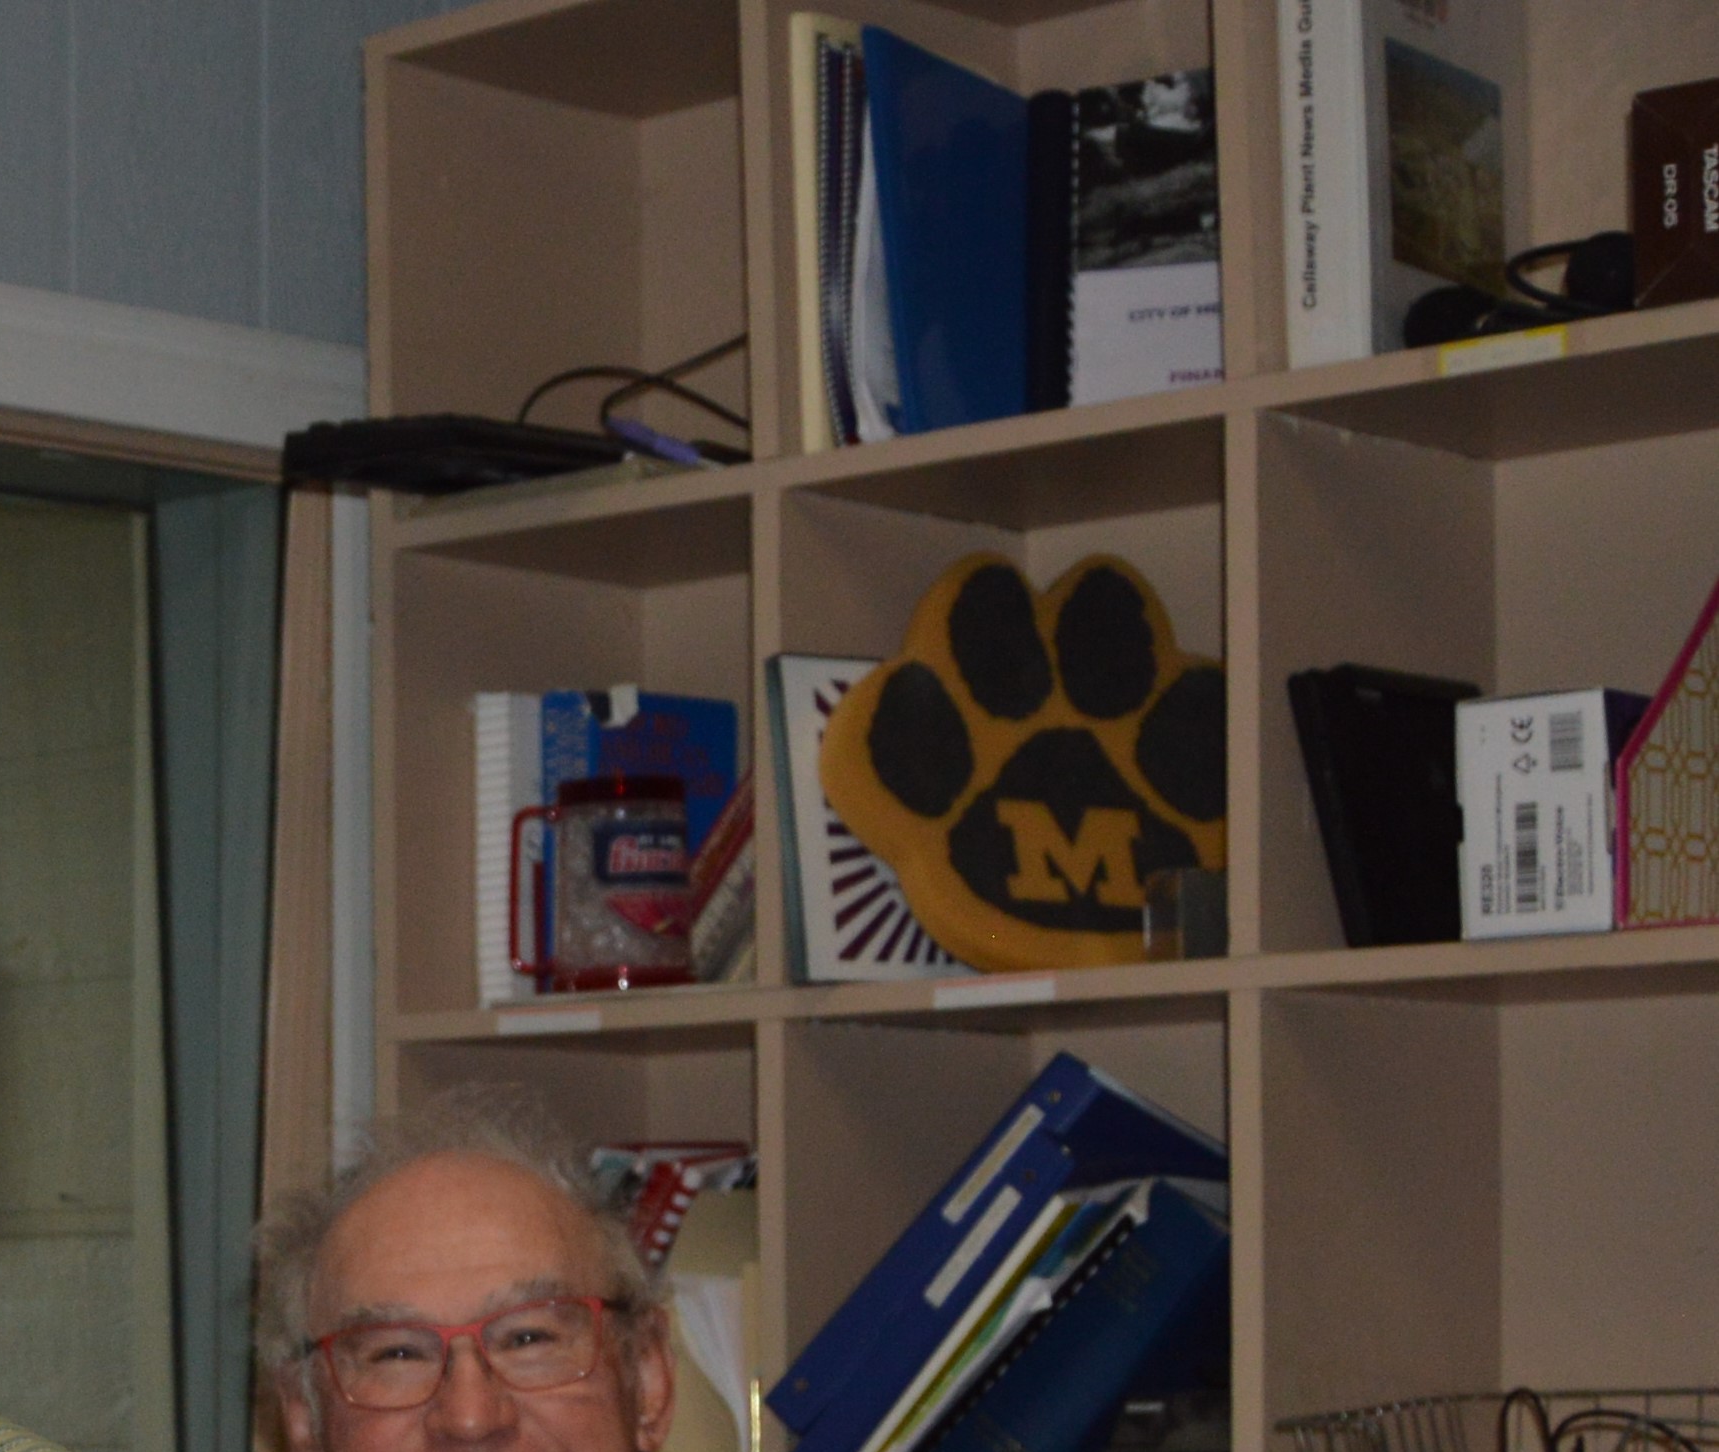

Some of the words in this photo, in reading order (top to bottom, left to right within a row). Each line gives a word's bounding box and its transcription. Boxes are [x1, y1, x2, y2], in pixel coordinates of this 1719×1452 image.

[1298, 39, 1314, 98] Media
[1301, 106, 1315, 158] News
[1301, 164, 1315, 215] Plant
[1703, 142, 1719, 233] TASCAM
[994, 801, 1150, 906] M
